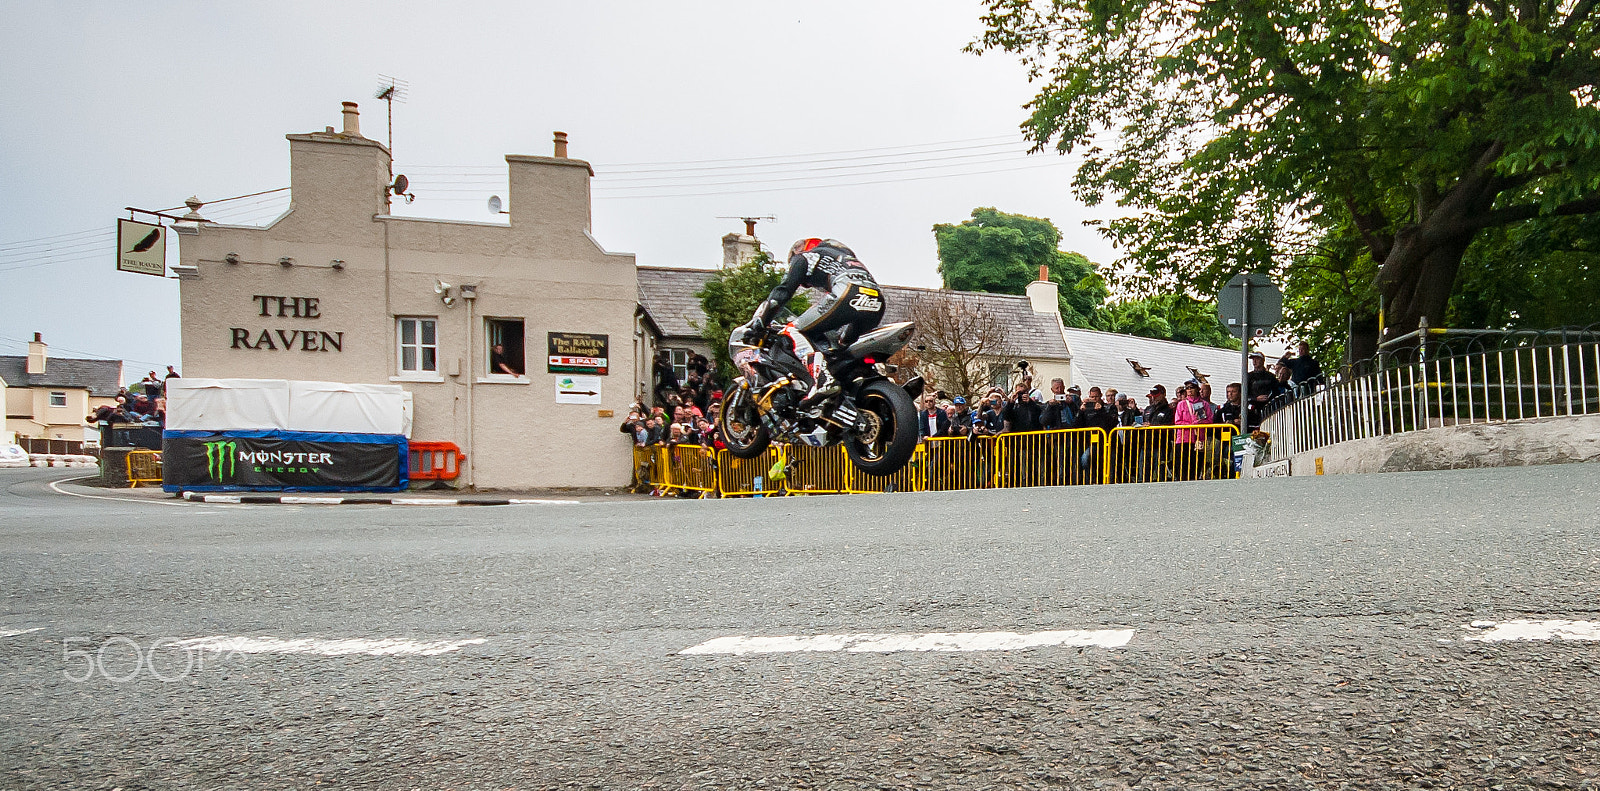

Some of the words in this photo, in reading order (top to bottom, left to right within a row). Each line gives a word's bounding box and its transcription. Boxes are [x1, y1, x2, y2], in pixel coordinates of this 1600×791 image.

[139, 261, 162, 269] RAVEN
[253, 295, 321, 318] THE
[229, 327, 344, 352] RAVEN
[552, 337, 570, 346] The
[572, 339, 605, 347] RAVEN
[557, 346, 599, 355] Ballaugh
[239, 449, 334, 465] MONSTER
